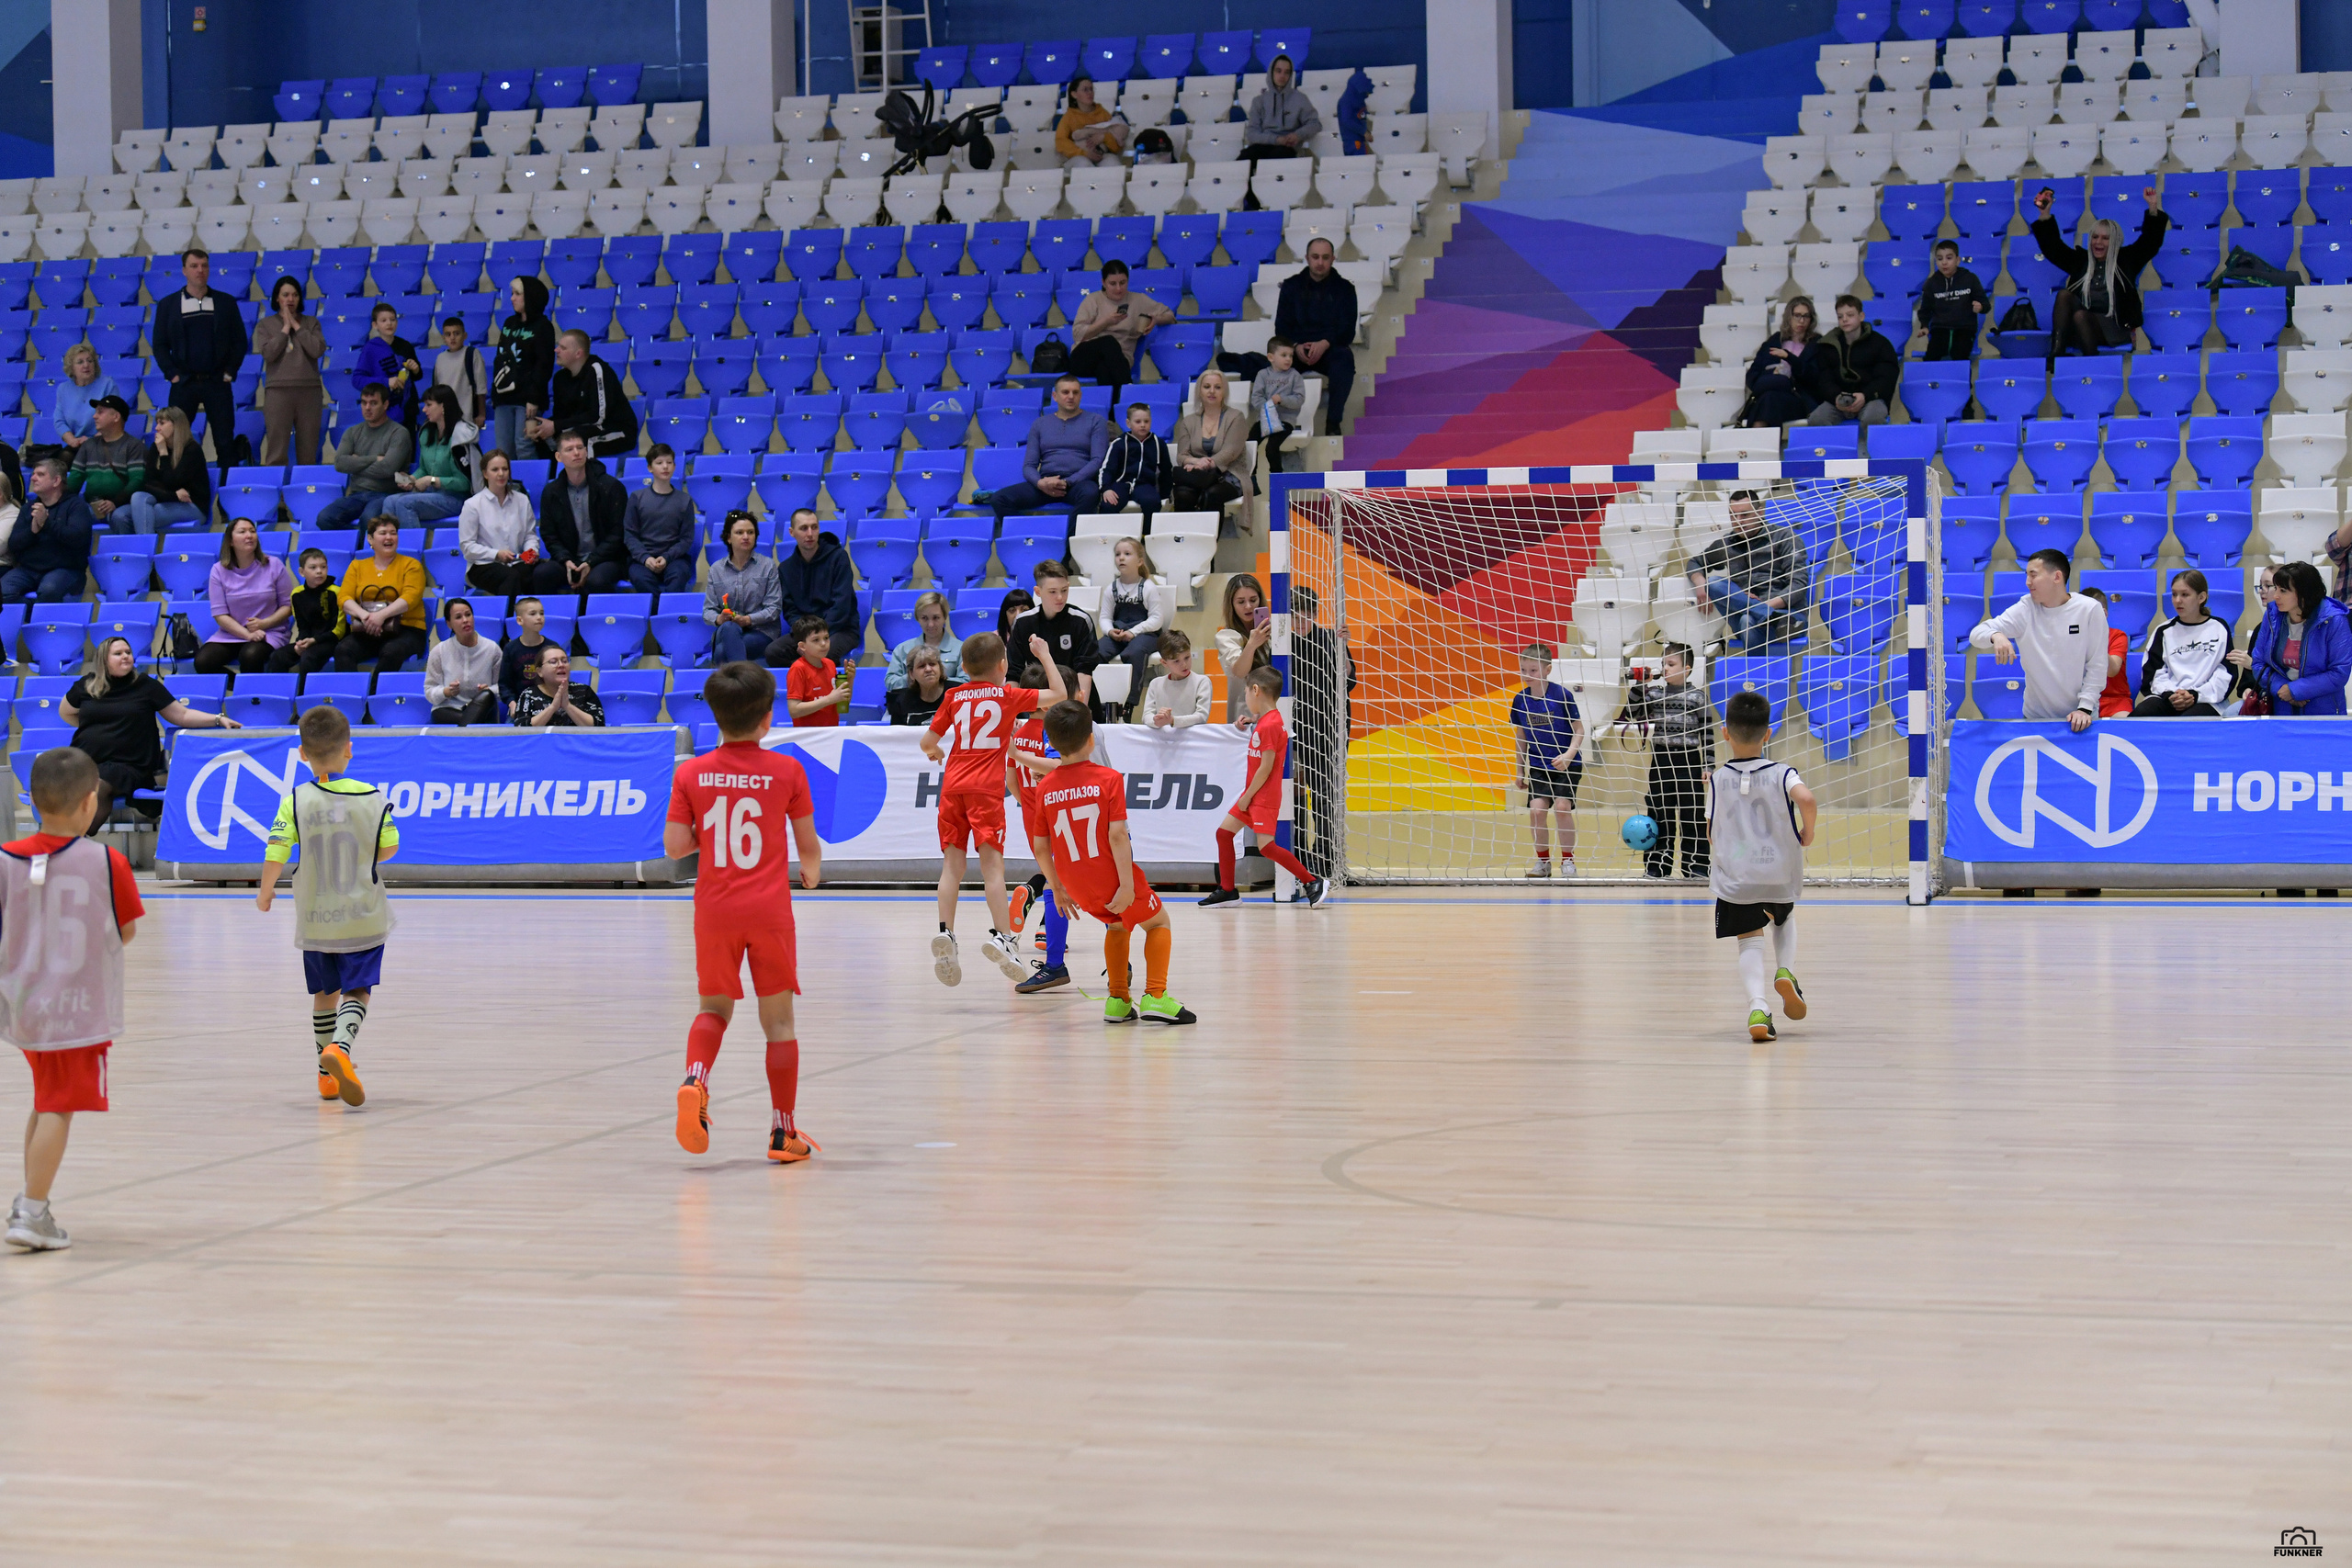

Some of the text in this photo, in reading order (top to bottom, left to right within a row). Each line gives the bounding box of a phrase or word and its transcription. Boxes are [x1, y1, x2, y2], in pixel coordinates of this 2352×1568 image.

[954, 687, 1004, 702] ЕВДОКИМОВ
[954, 700, 1002, 750] 12
[1014, 738, 1043, 750] ЯГИН
[698, 773, 773, 789] ШЕЛЕСТ
[1722, 774, 1770, 791] ЛЫИН
[1044, 785, 1101, 807] БЕЛОГЛАЗОВ
[303, 808, 353, 829] MESI
[1726, 797, 1773, 840] 10
[703, 795, 763, 870] 16
[1054, 803, 1101, 863] 17
[308, 831, 358, 897] 10
[1148, 894, 1158, 910] 17
[305, 905, 346, 923] unicef
